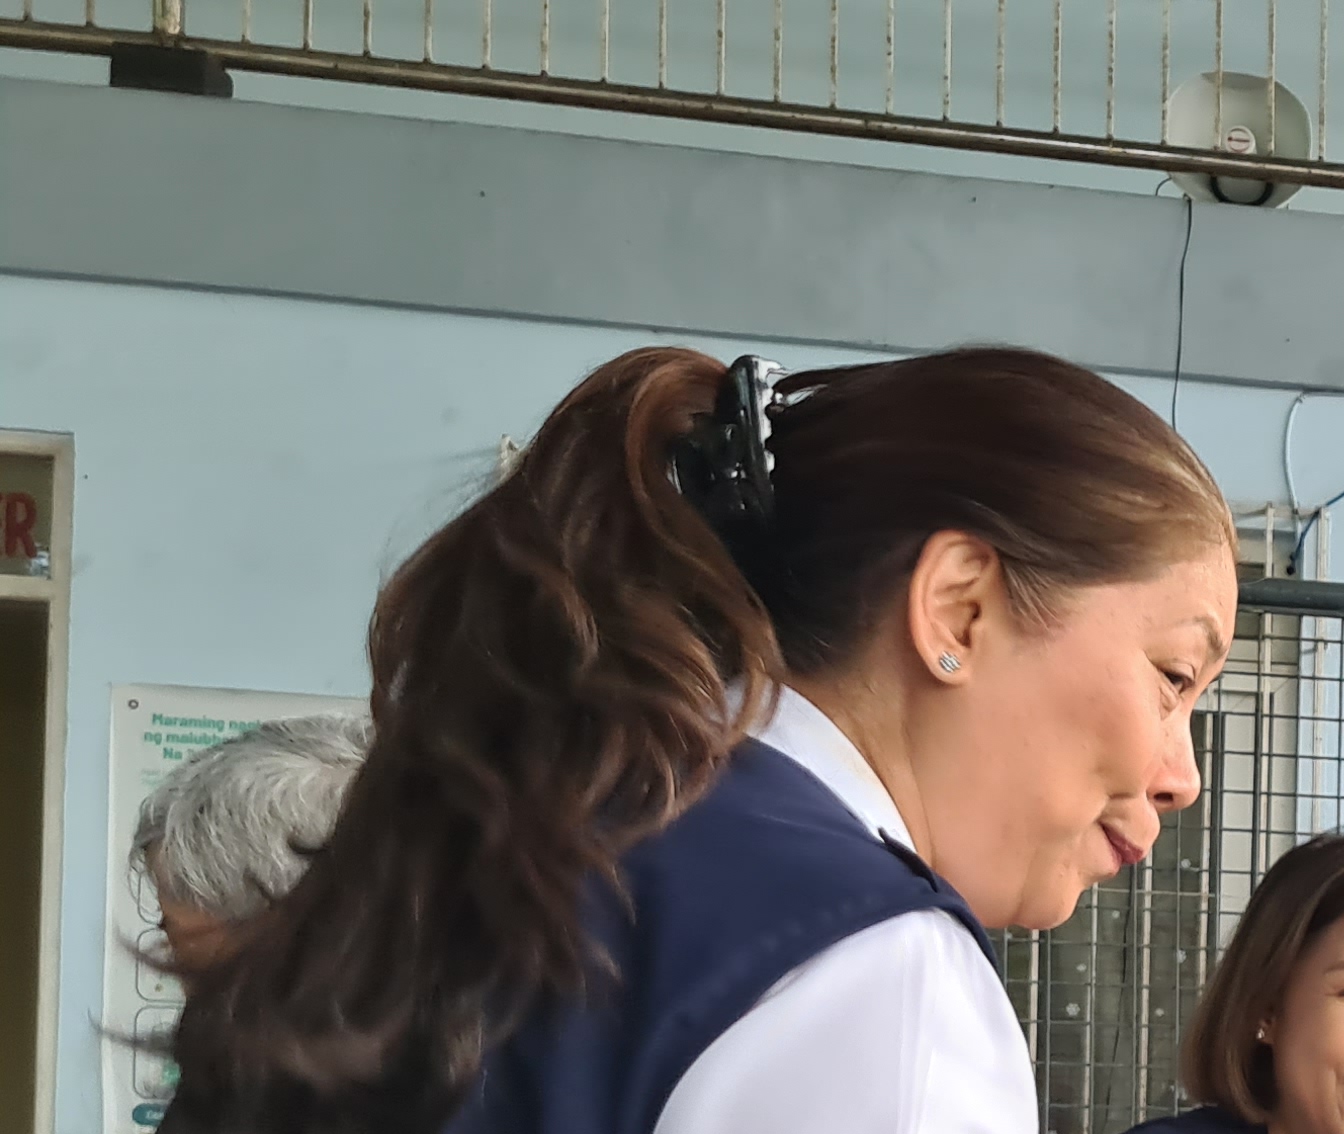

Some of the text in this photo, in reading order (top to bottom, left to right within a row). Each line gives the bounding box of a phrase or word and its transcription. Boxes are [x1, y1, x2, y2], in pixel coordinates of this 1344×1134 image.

[0, 492, 37, 558] R
[152, 713, 225, 732] Maraming
[144, 731, 224, 747] ng malubh
[163, 747, 182, 760] Na
